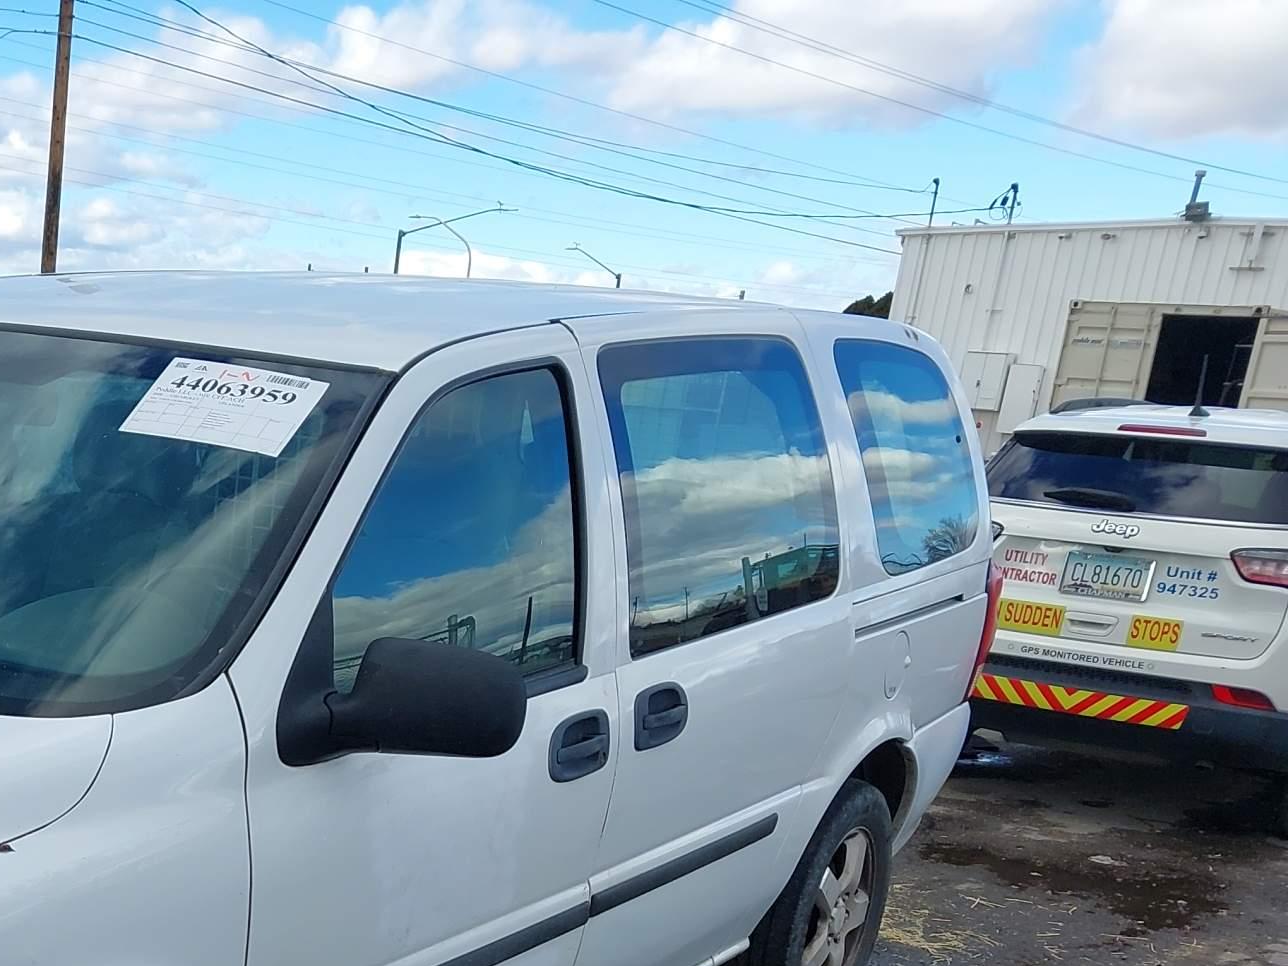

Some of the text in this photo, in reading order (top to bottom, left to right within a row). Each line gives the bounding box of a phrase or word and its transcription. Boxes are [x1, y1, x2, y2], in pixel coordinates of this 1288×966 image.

[171, 375, 298, 405] 44063959
[1091, 519, 1140, 539] Jeep
[1005, 549, 1049, 566] UTILITY
[995, 565, 1057, 586] NTRACTOR
[1071, 562, 1143, 589] CL81670
[1166, 566, 1219, 583] Unit #
[1156, 582, 1220, 600] 947325
[1004, 602, 1062, 628] SUDDEN
[1130, 618, 1180, 645] STOPS
[1020, 645, 1145, 671] GPS MONITORED VEHICLE
